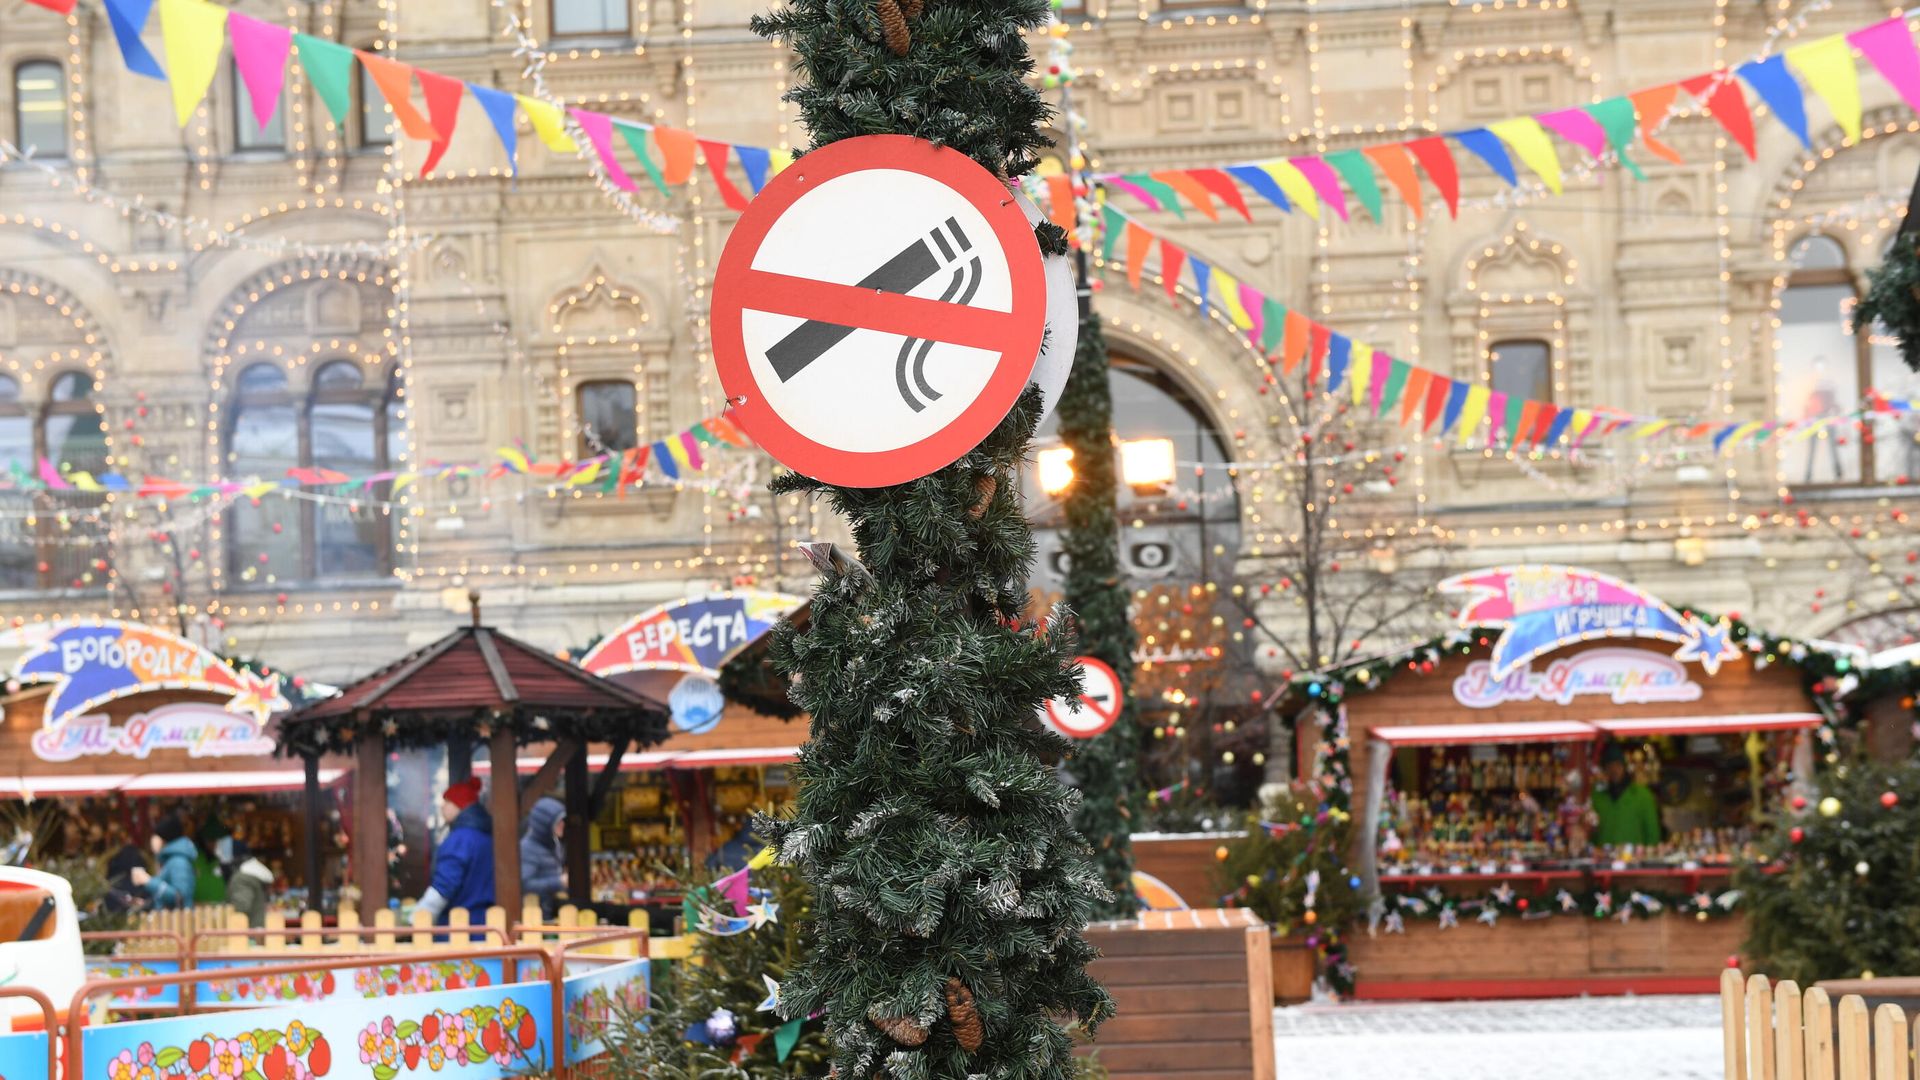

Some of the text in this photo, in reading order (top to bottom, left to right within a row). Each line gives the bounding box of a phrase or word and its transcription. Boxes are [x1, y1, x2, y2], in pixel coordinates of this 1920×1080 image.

[626, 610, 748, 661] БЕРЕСТА
[1554, 603, 1648, 635] ИГРУШКА
[61, 634, 204, 677] БОГОРОДКА
